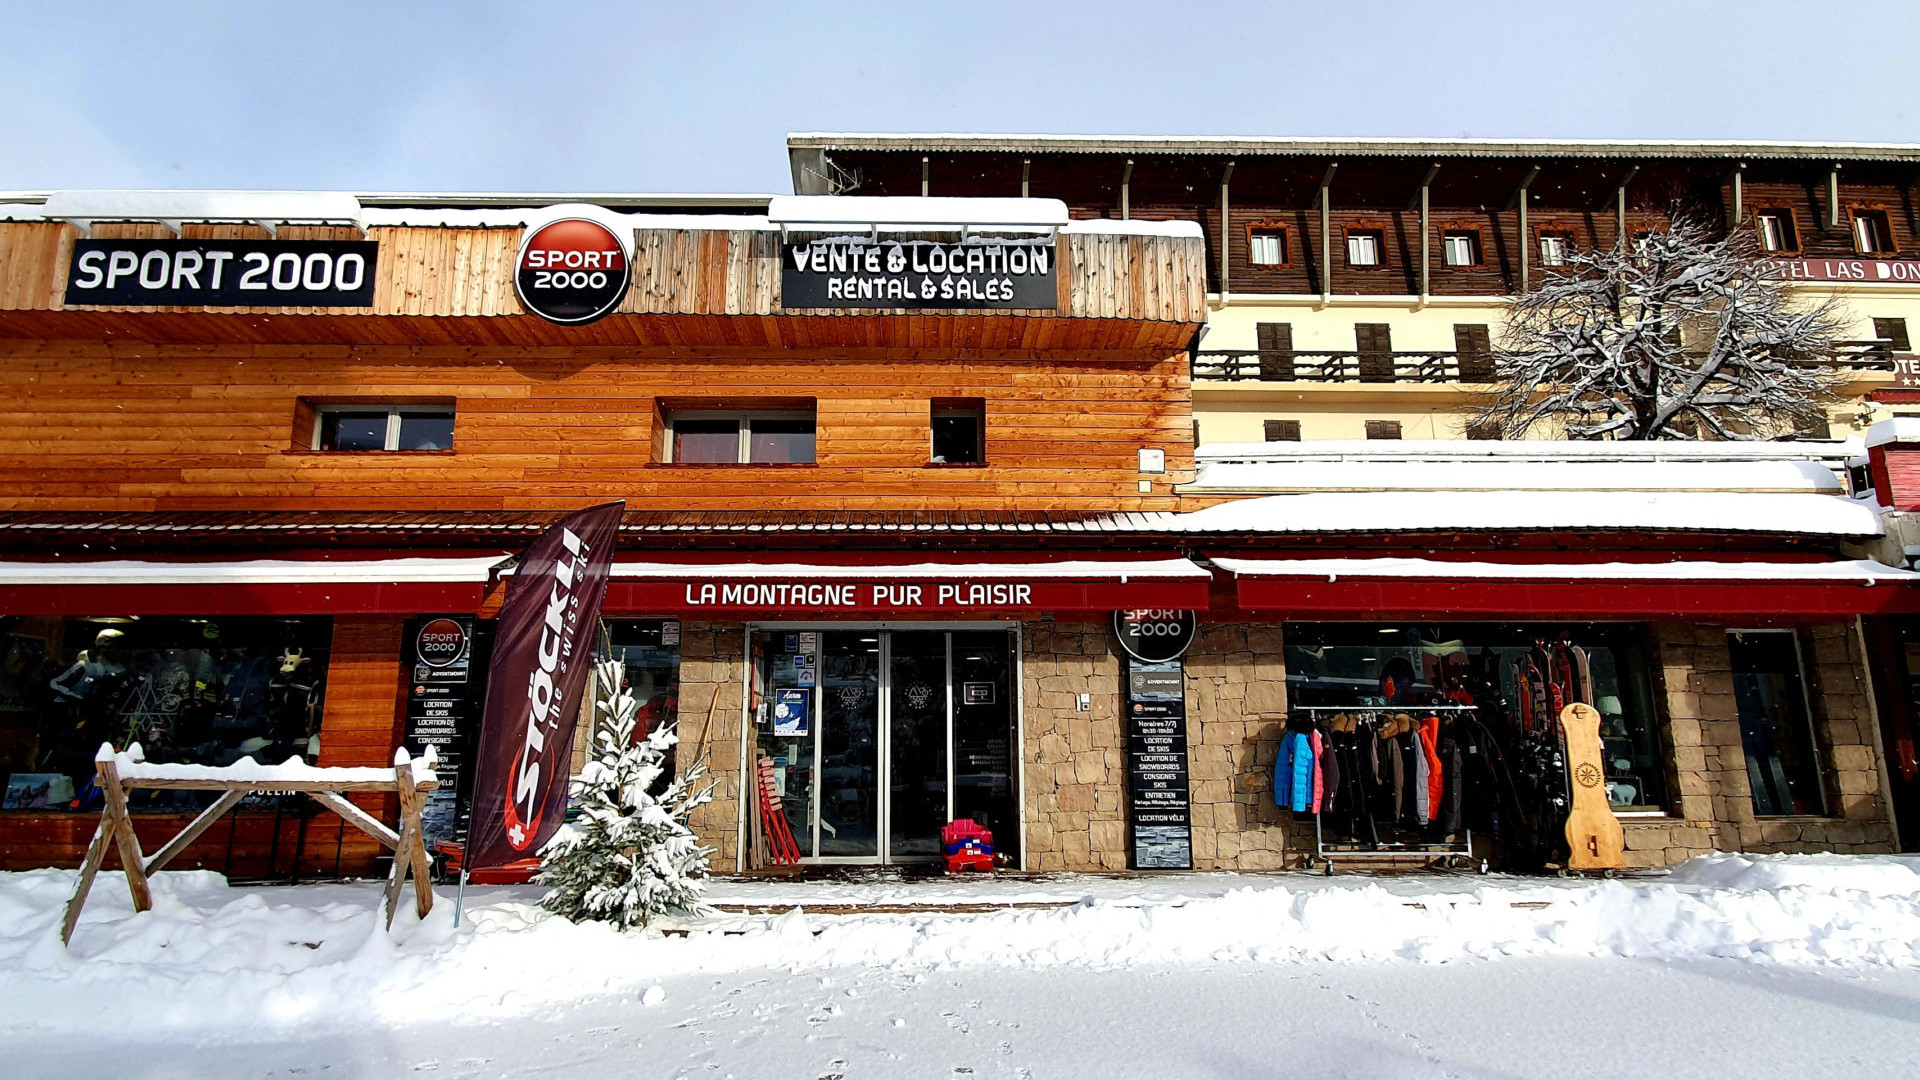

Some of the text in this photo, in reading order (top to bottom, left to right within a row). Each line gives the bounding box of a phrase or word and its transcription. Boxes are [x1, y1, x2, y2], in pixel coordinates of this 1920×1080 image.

[528, 250, 617, 268] SPORT
[792, 242, 1048, 274] VENTE & LOCATION
[75, 250, 365, 290] SPORT 2000
[1825, 261, 1865, 279] LAS
[534, 271, 607, 289] 2000
[827, 275, 1014, 300] RENTAL & SALES
[685, 584, 1031, 605] LA MONTAGNE PUR PLAISIR
[1123, 609, 1183, 620] SPORT
[422, 633, 460, 642] SPORT
[548, 541, 591, 730] the swiss ski
[1129, 623, 1181, 636] 2000
[424, 643, 456, 652] 2000
[516, 527, 581, 831] STÖCKLI
[447, 719, 455, 727] DE
[1169, 814, 1185, 822] VÉLO
